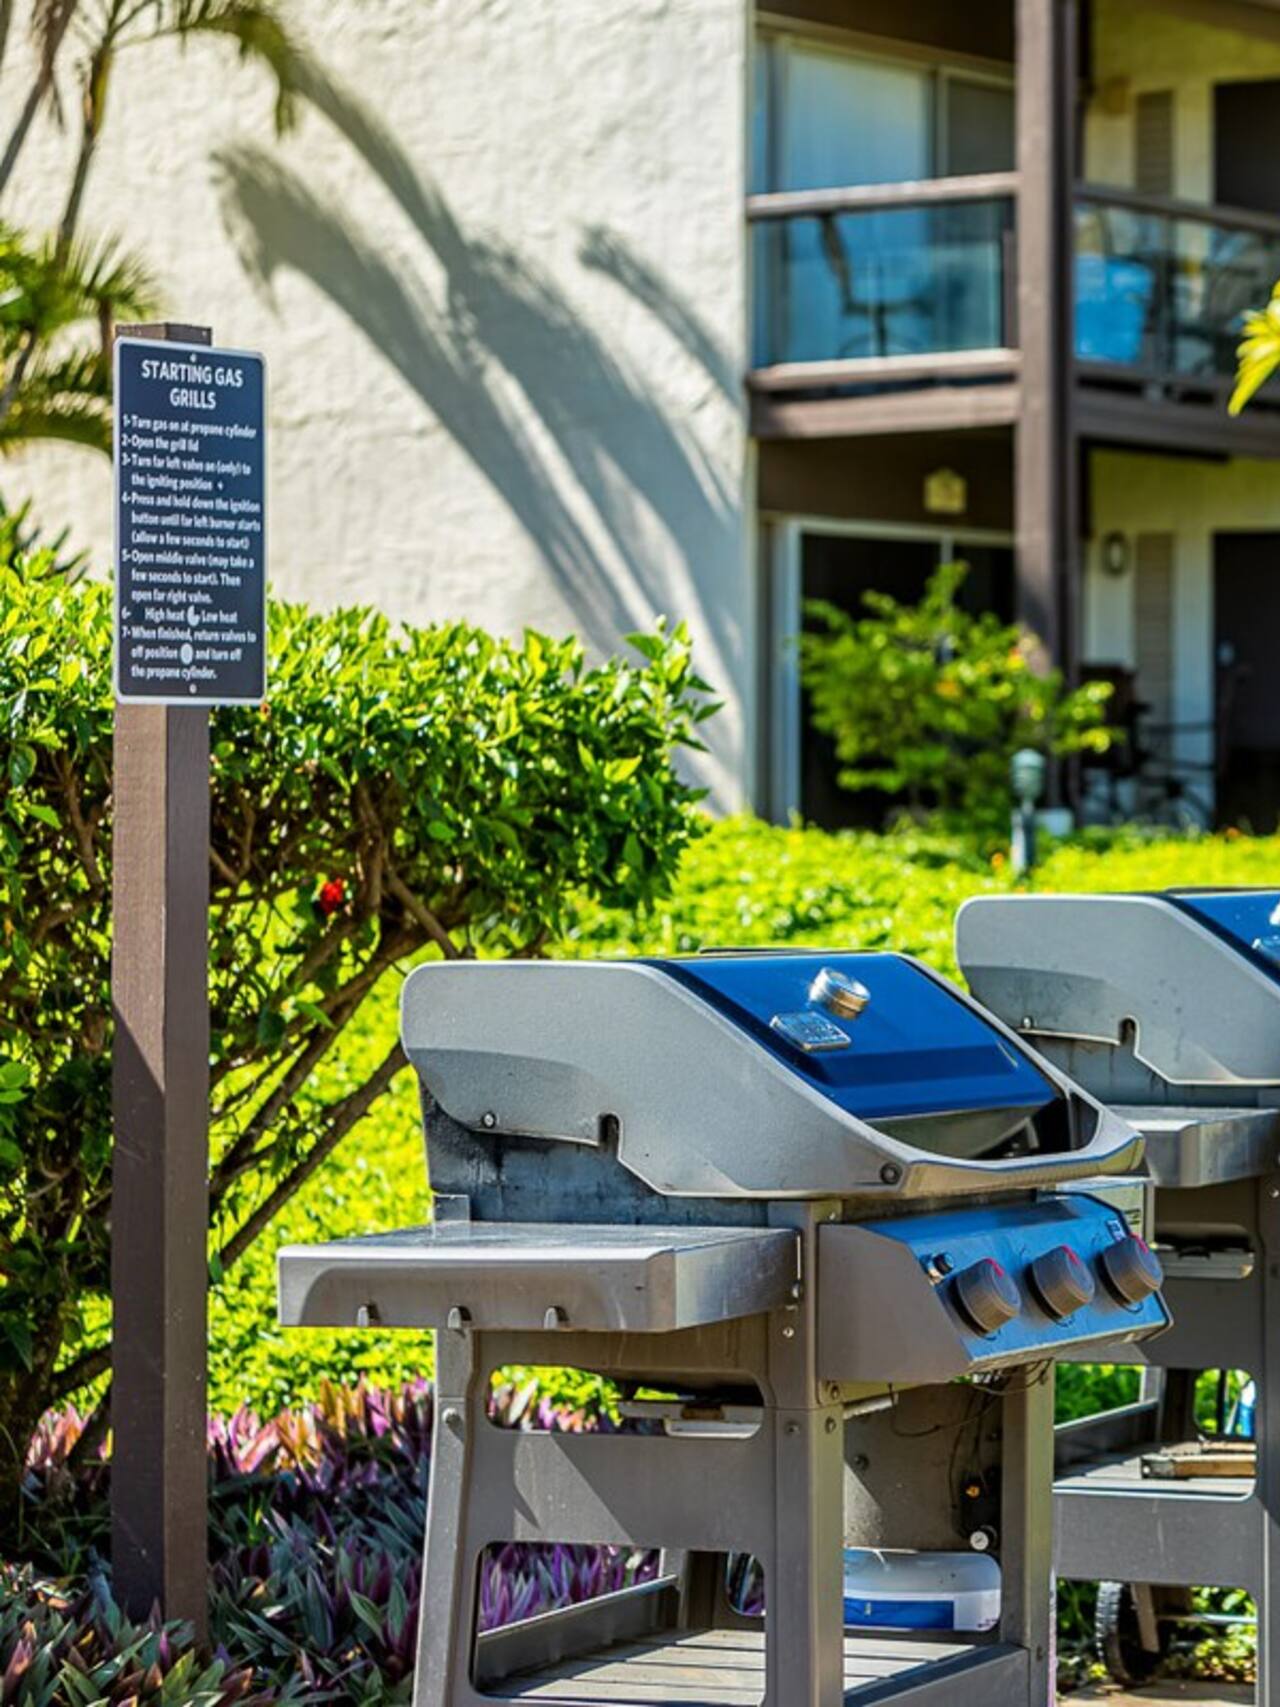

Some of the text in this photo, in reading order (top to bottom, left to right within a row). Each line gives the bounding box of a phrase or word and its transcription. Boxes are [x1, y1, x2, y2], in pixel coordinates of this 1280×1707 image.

[141, 359, 243, 388] STARTING GAS
[169, 387, 217, 410] GRILLS
[153, 419, 168, 433] gas
[169, 421, 180, 432] on
[181, 420, 189, 432] at
[191, 422, 223, 436] propane
[225, 422, 257, 439] cylinder
[155, 436, 169, 449] the
[170, 437, 187, 454] grill
[188, 439, 199, 452] lid
[166, 455, 181, 470] left
[182, 458, 203, 472] valve
[205, 461, 215, 473] on
[242, 463, 251, 475] to
[131, 472, 213, 492] the igniting position
[156, 494, 171, 507] and
[173, 494, 190, 508] hold
[192, 496, 214, 510] down
[215, 498, 229, 511] the
[230, 498, 260, 514] ignition
[131, 510, 159, 525] button
[161, 513, 180, 527] until
[194, 515, 208, 528] left
[209, 516, 236, 530] burner
[238, 518, 261, 532] starts
[131, 530, 250, 550] (allow a few seconds to start)
[155, 551, 183, 565] middle
[185, 553, 206, 567] valve
[207, 554, 229, 570] (may
[230, 555, 247, 569] take
[249, 557, 255, 569] a
[131, 567, 147, 582] few
[149, 570, 182, 584] seconds
[183, 571, 192, 584] to
[220, 572, 241, 586] Then
[131, 589, 152, 603] open
[167, 589, 186, 605] right
[144, 607, 165, 623] High
[166, 608, 185, 621] heat
[201, 610, 218, 623] Low
[219, 610, 238, 624] heat
[157, 626, 193, 642] finished,
[194, 628, 219, 642] return
[221, 629, 246, 643] valves
[247, 630, 257, 643] to
[130, 644, 242, 661] off position and turn off
[131, 664, 145, 678] the
[146, 666, 180, 680] propane
